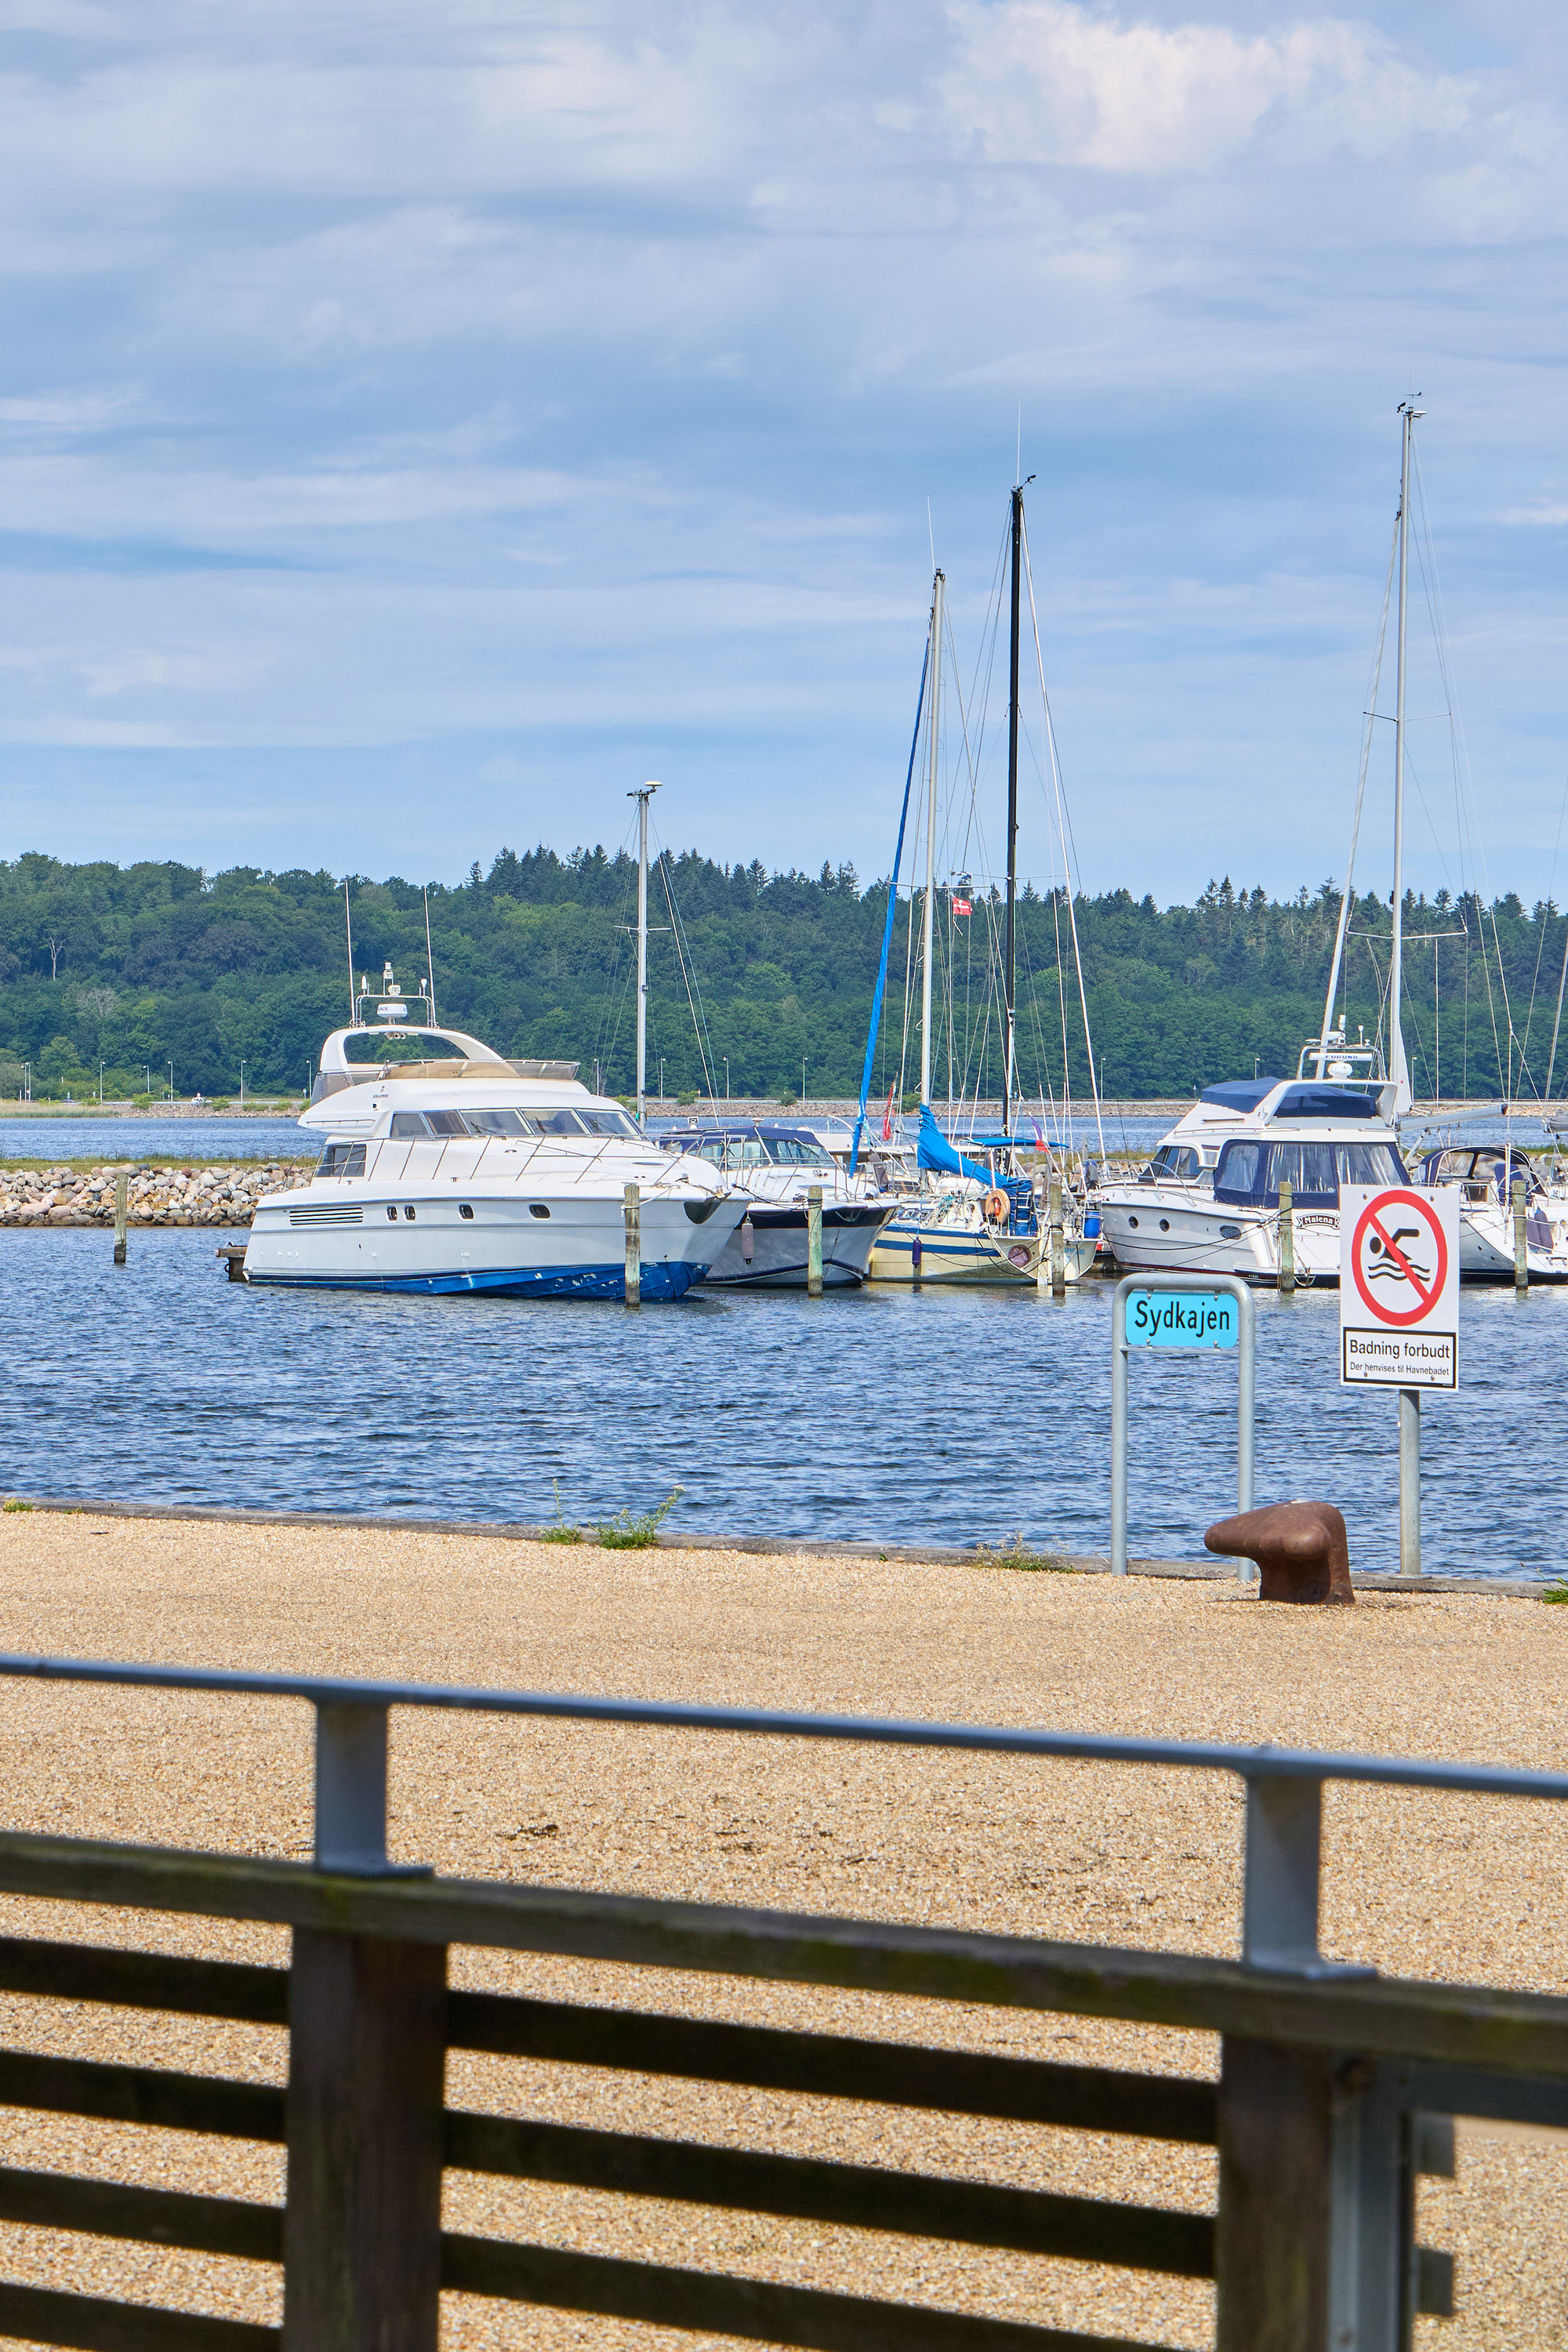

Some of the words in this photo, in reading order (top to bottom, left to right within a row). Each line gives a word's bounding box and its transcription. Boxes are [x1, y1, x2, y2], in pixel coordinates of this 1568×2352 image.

[1305, 1216, 1333, 1225] Malena
[1134, 1300, 1229, 1338] Sydkajen
[1350, 1340, 1400, 1359] Badning
[1403, 1342, 1450, 1359] forbudt
[1350, 1362, 1363, 1370] Der
[1364, 1363, 1396, 1373] henvises
[1406, 1365, 1450, 1376] Havnebadet
